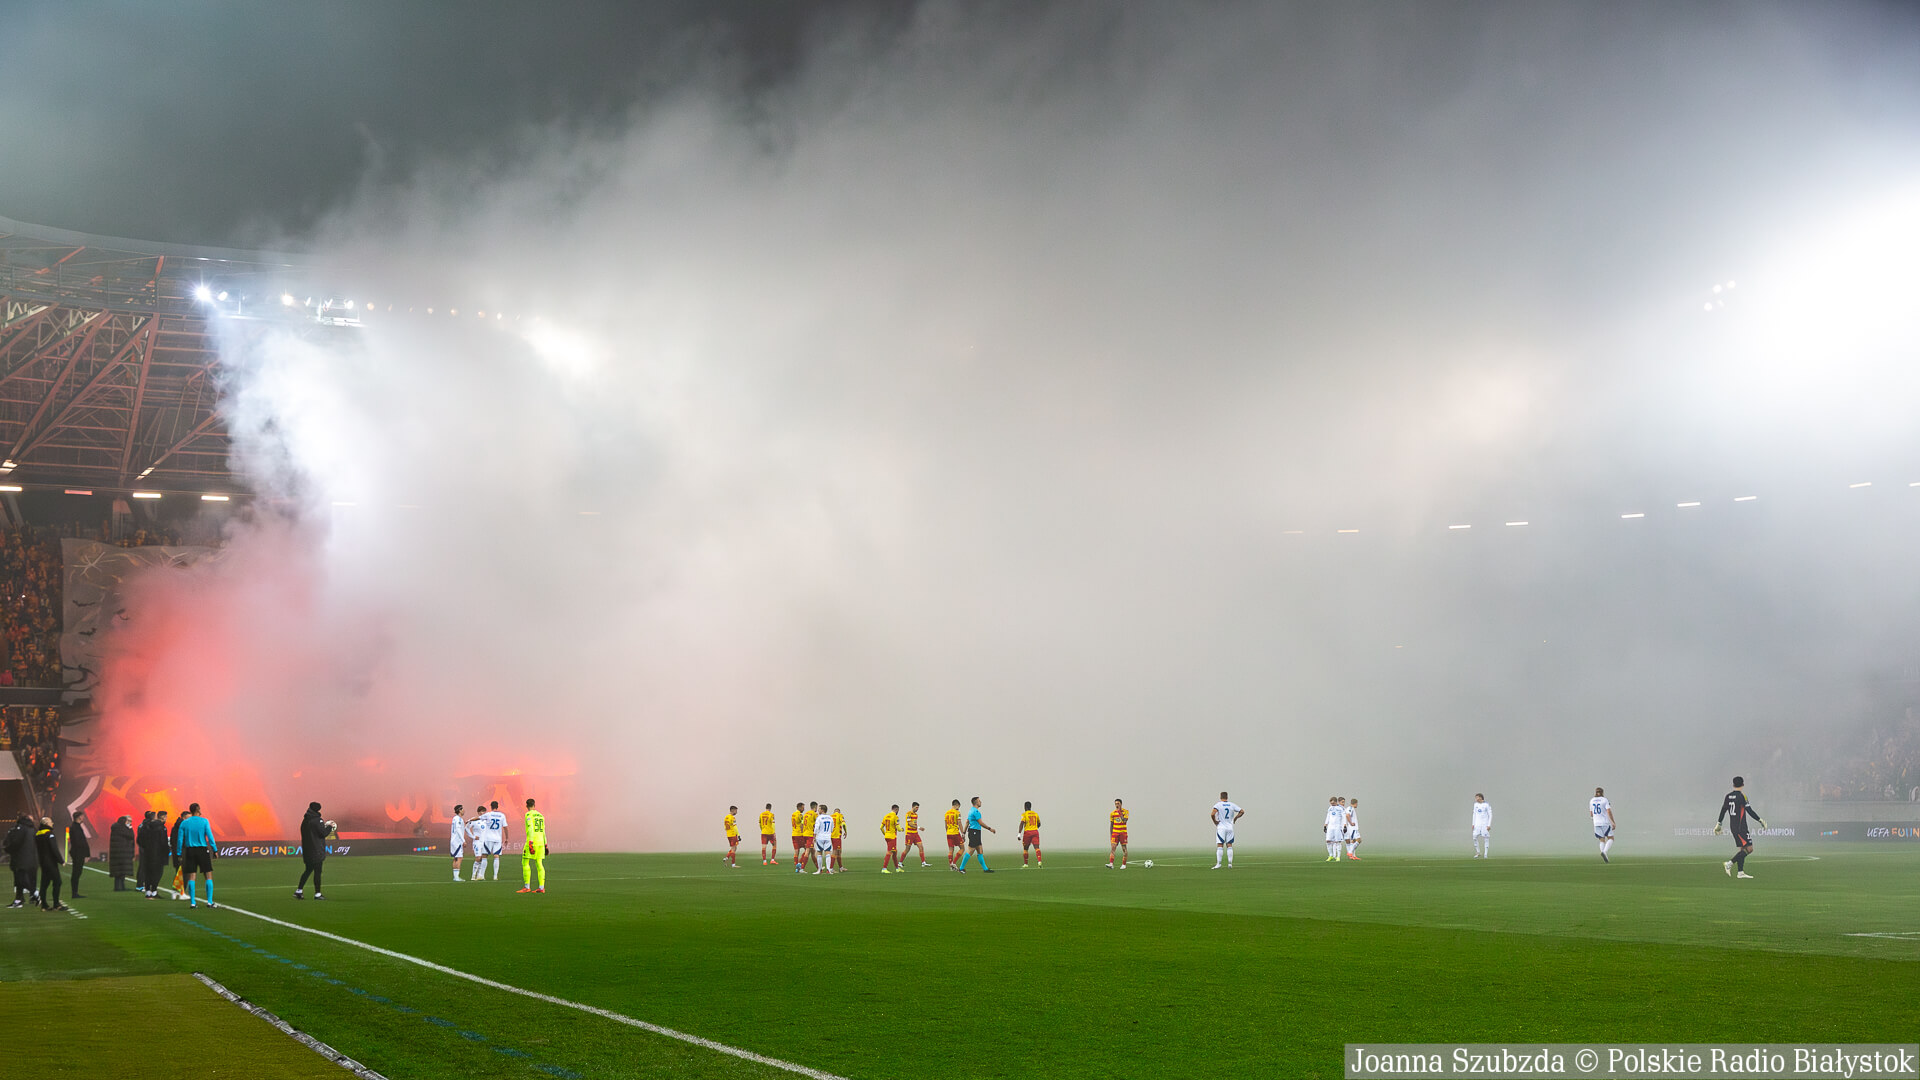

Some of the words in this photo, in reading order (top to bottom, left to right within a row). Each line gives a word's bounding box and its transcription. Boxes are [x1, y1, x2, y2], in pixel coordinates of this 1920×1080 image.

[1224, 807, 1230, 820] 2
[1592, 803, 1602, 815] 26
[489, 818, 500, 830] 25
[823, 820, 831, 833] 17
[1757, 828, 1795, 837] CHAMPION
[1866, 827, 1890, 838] UEFA
[220, 846, 249, 856] UEFA
[252, 845, 333, 856] FOUNDAN
[334, 845, 350, 856] .org
